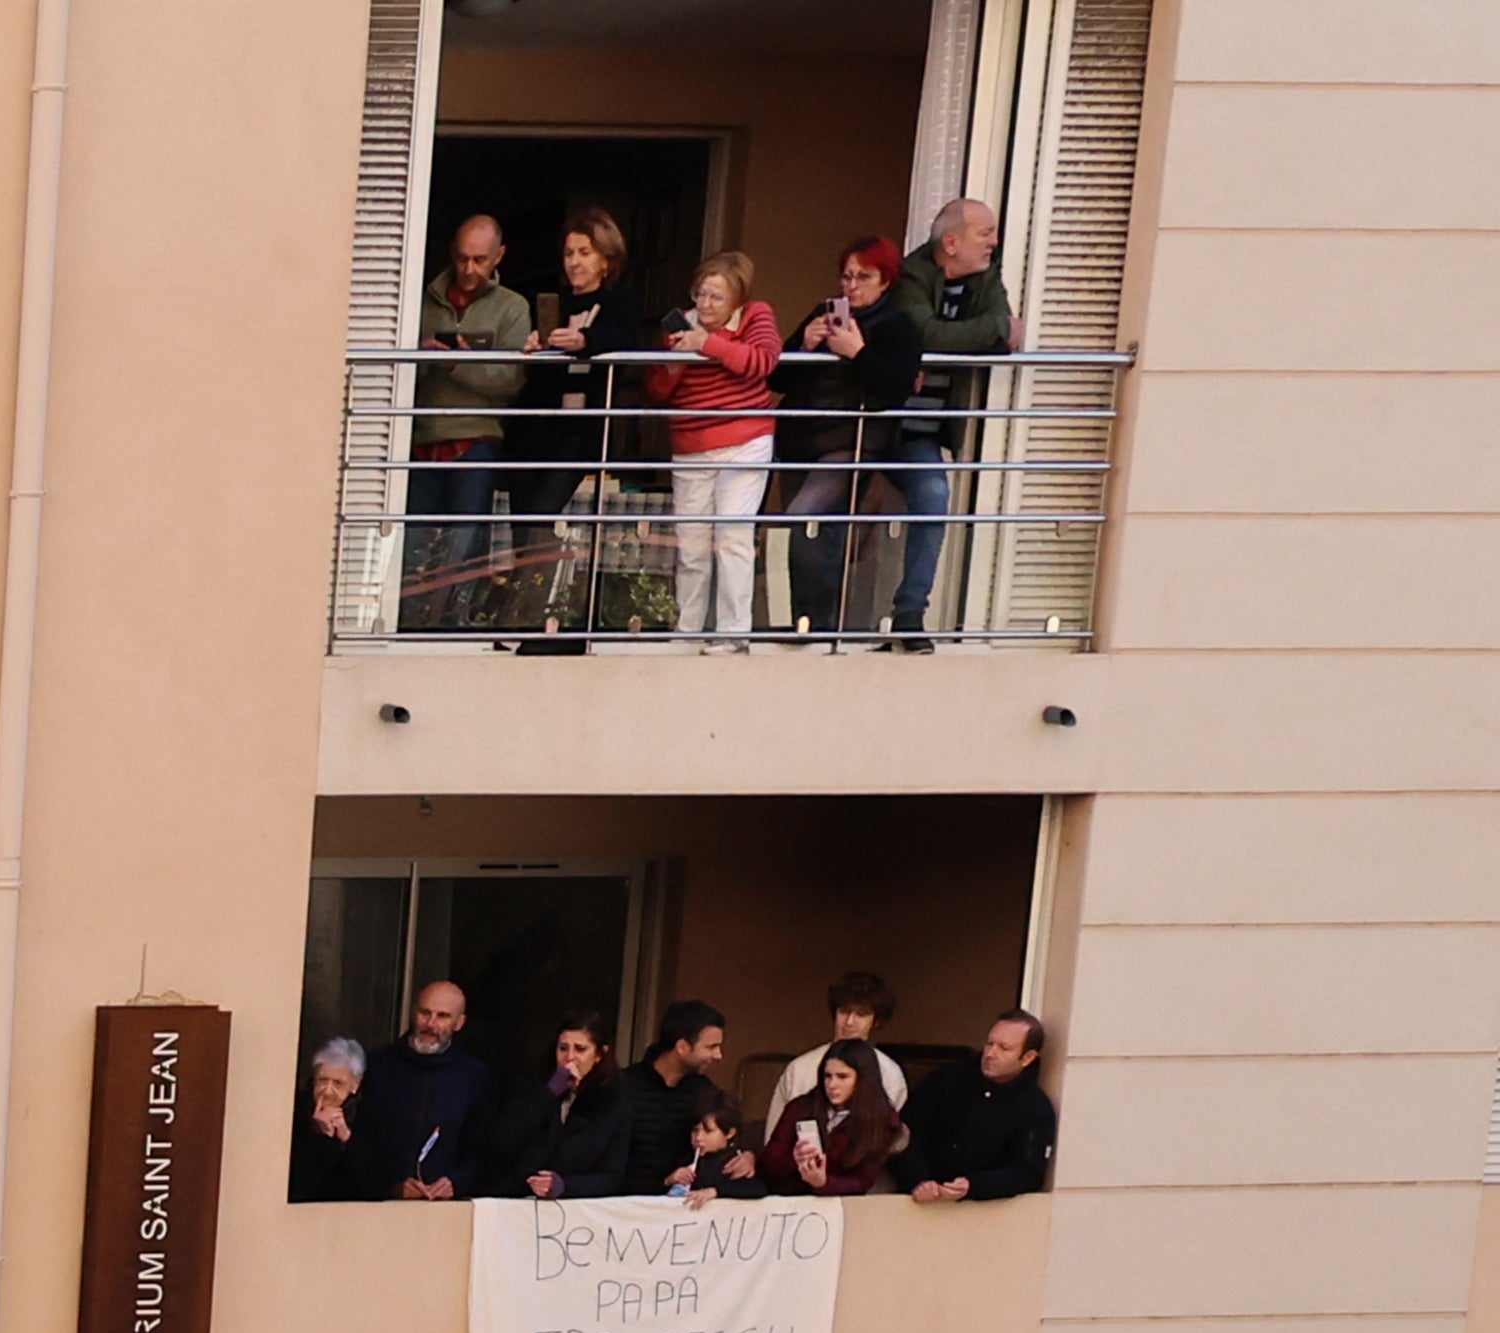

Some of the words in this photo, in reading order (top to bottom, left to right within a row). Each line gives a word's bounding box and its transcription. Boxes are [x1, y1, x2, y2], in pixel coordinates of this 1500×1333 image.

[147, 1031, 180, 1124] JEAN
[140, 1133, 173, 1241] SAINT
[596, 1276, 699, 1324] PAPA
